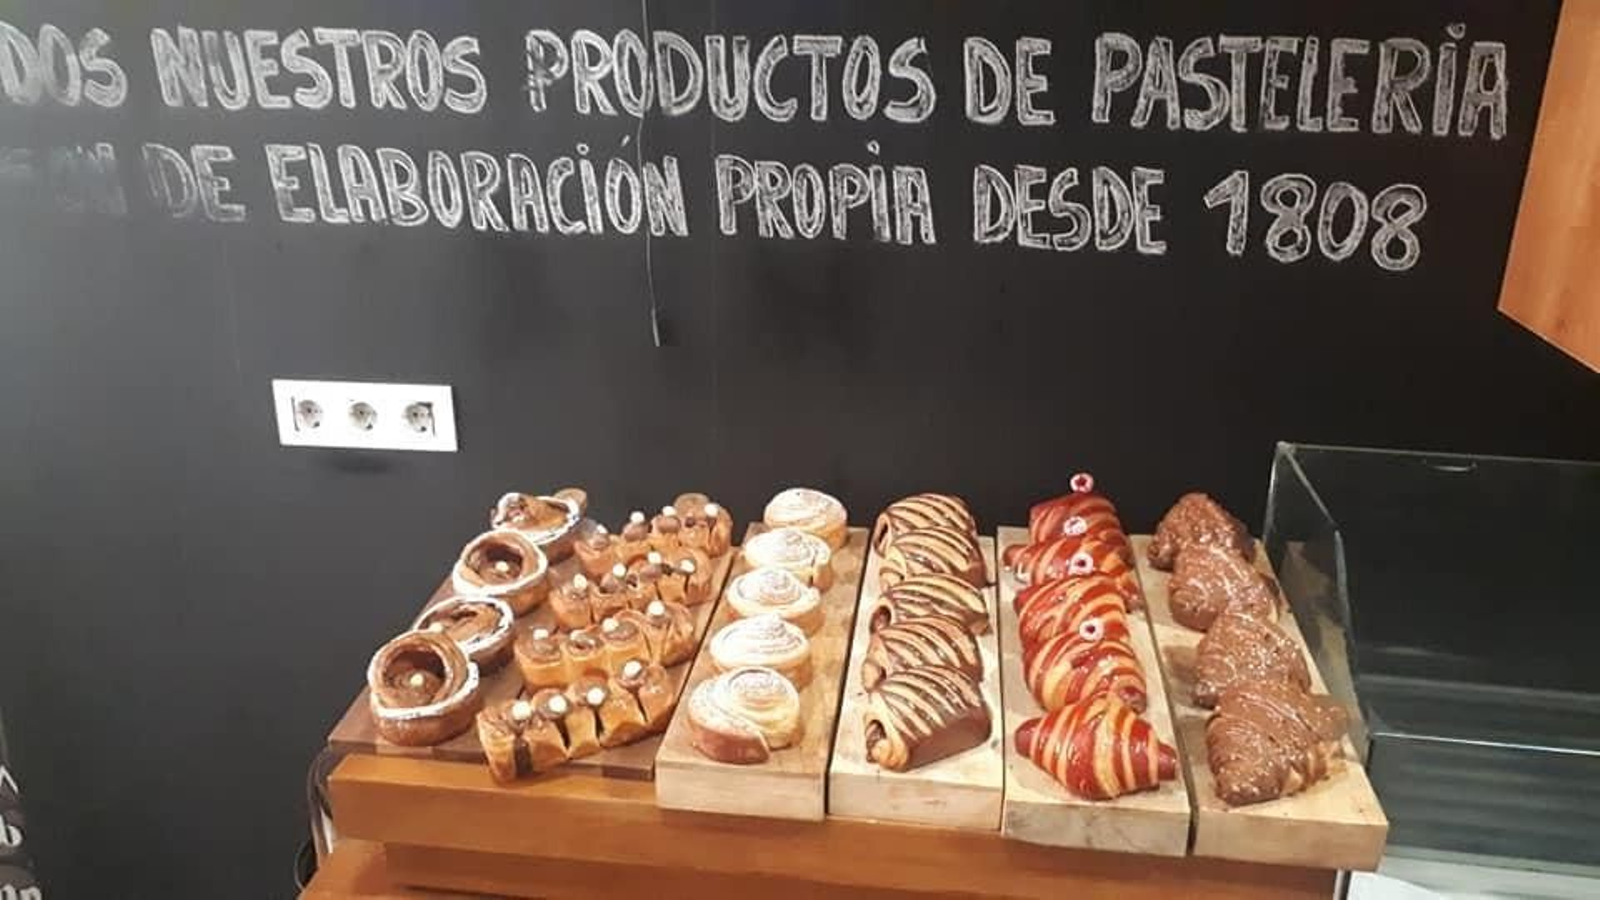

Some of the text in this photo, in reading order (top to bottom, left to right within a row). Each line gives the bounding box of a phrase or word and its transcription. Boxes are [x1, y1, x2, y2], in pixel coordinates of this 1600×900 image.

[0, 20, 128, 107] DOS
[150, 26, 488, 114] NUESTROS
[525, 28, 937, 123] PRODUCTOS
[964, 36, 1055, 126] DE
[141, 142, 246, 223] DE
[715, 139, 936, 244] PROPIA
[973, 164, 1167, 254] DESDE
[1203, 170, 1427, 271] 1808
